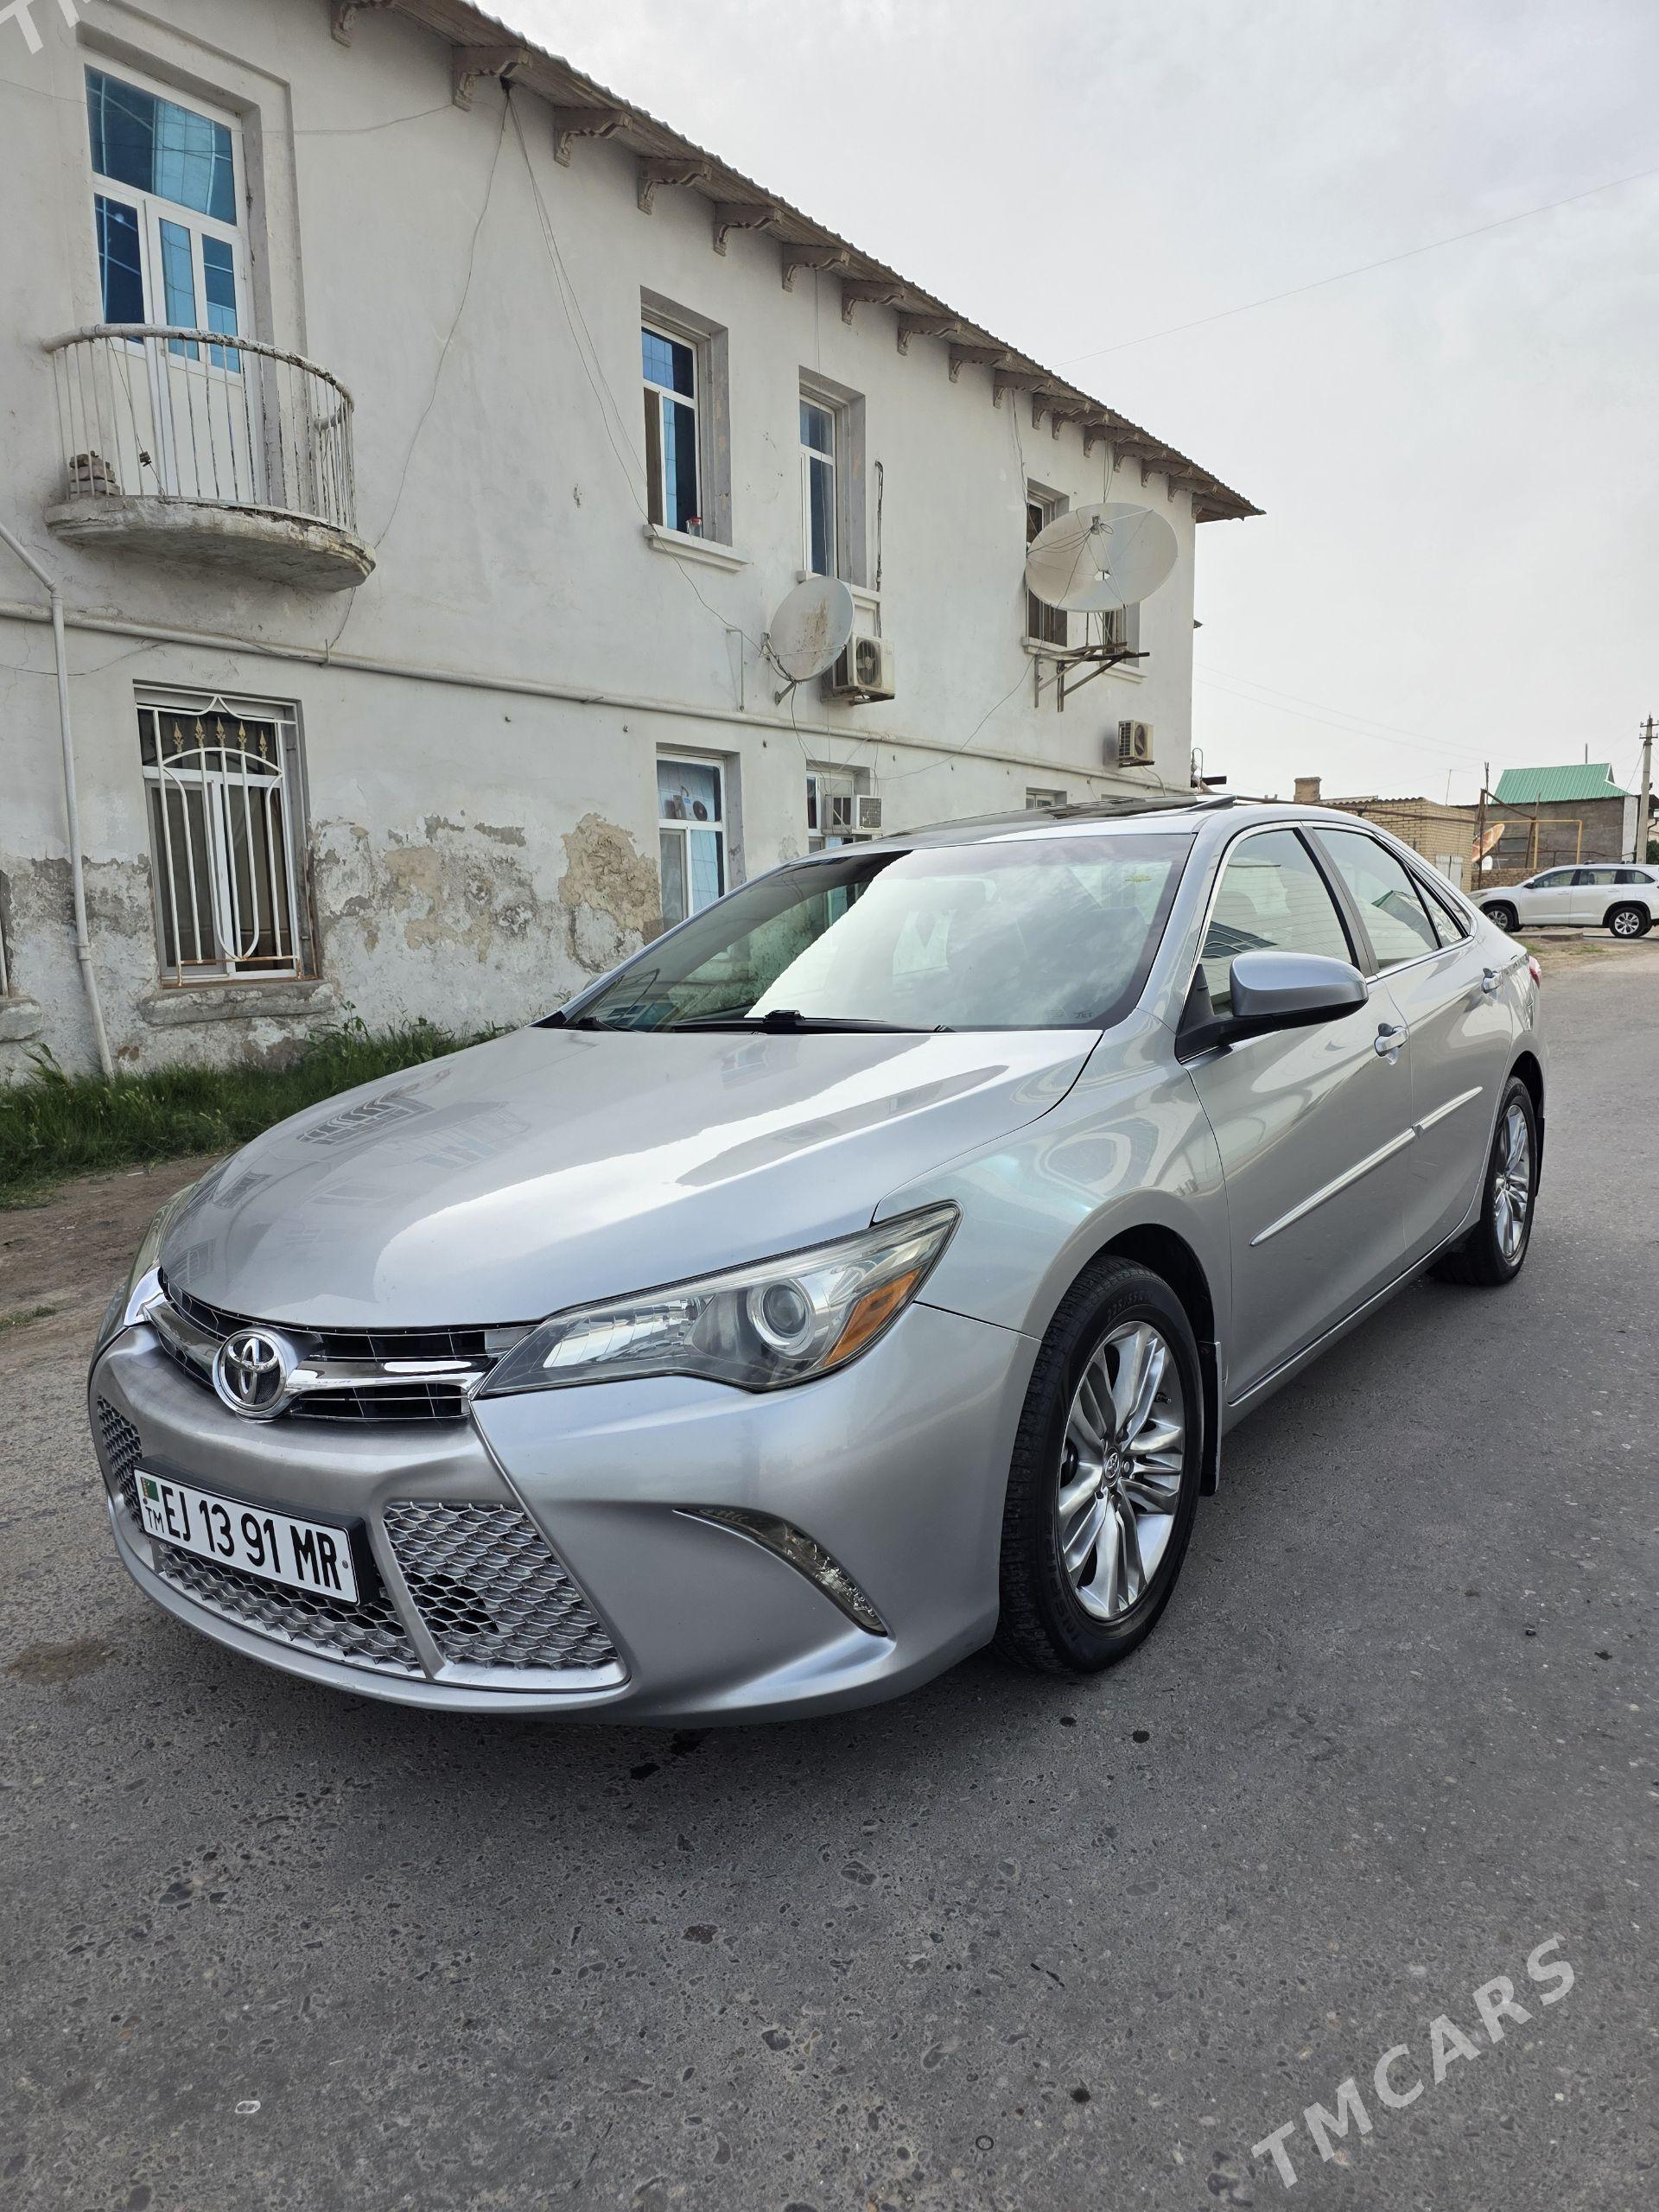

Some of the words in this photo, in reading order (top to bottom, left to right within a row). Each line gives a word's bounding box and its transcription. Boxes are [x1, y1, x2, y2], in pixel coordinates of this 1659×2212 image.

[145, 1506, 165, 1534] TM
[161, 1484, 191, 1541] EJ
[289, 1525, 342, 1591] MR
